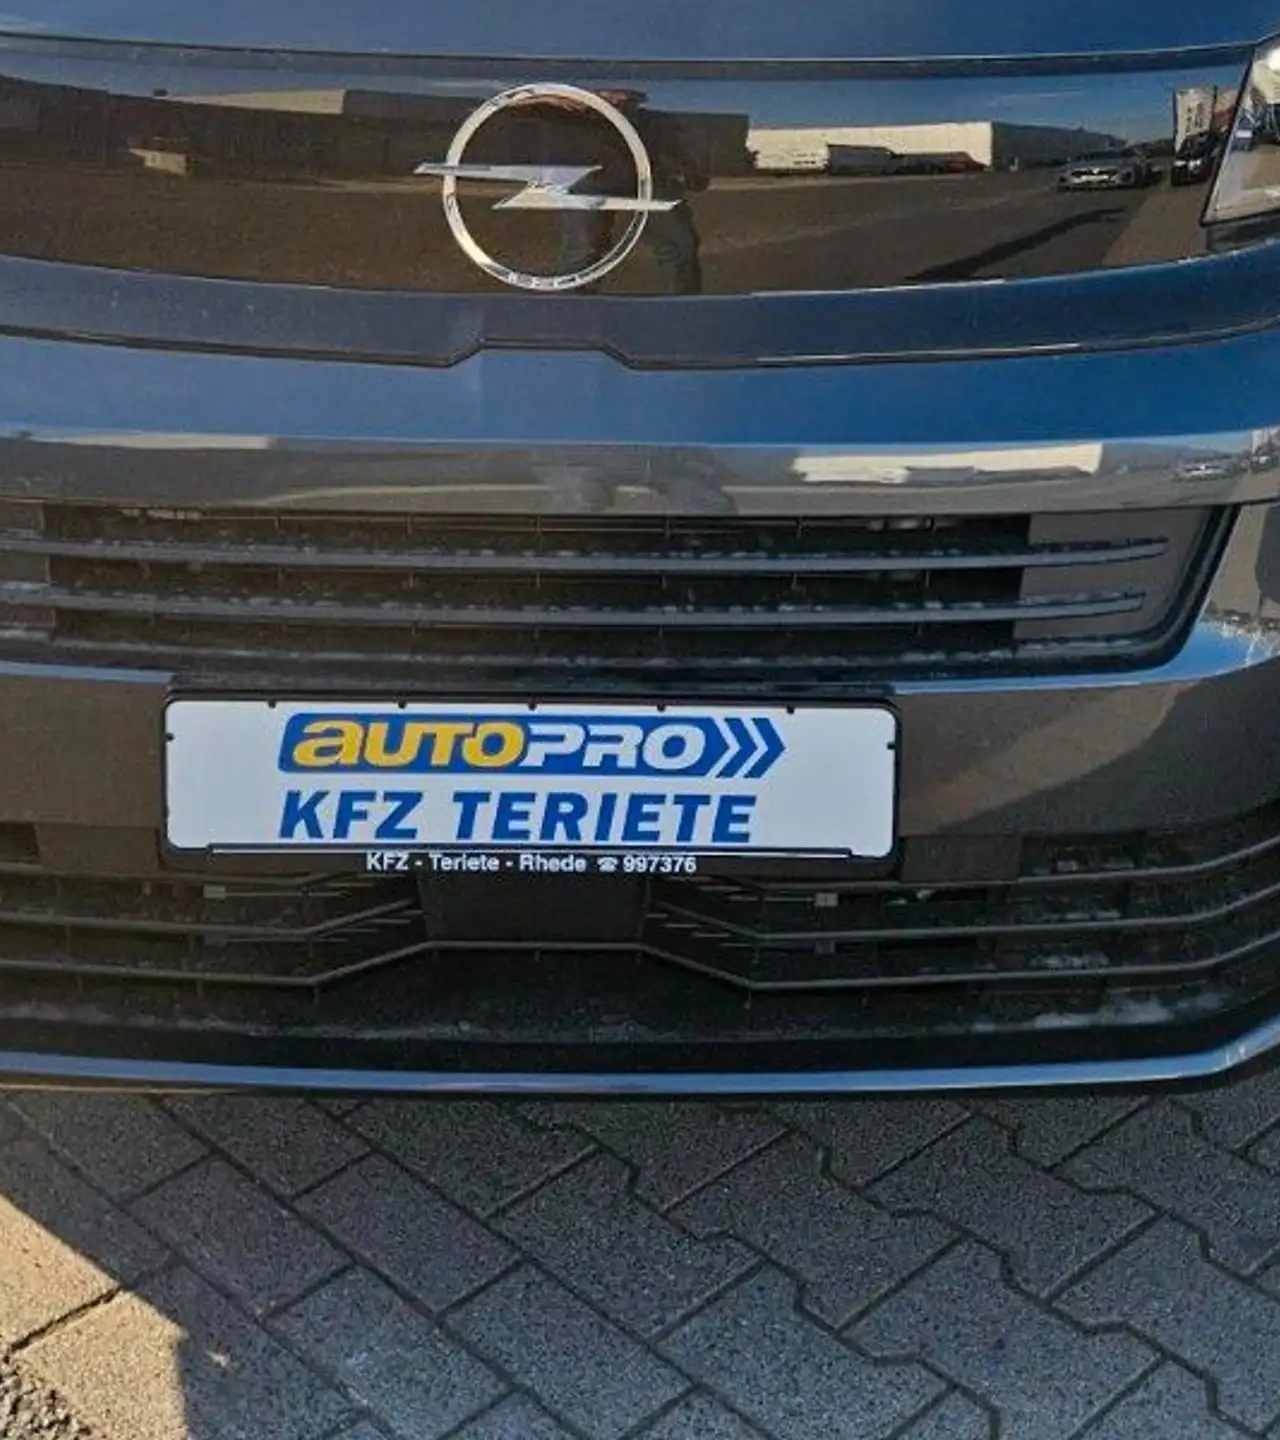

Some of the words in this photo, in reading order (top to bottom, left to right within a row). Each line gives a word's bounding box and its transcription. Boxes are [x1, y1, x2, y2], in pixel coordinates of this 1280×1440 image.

[277, 789, 424, 840] KFZ
[450, 791, 758, 844] TERIETE
[365, 852, 409, 871] KFZ
[428, 853, 500, 872] Teriete
[519, 854, 587, 872] Rhede
[622, 854, 697, 873] 997376
